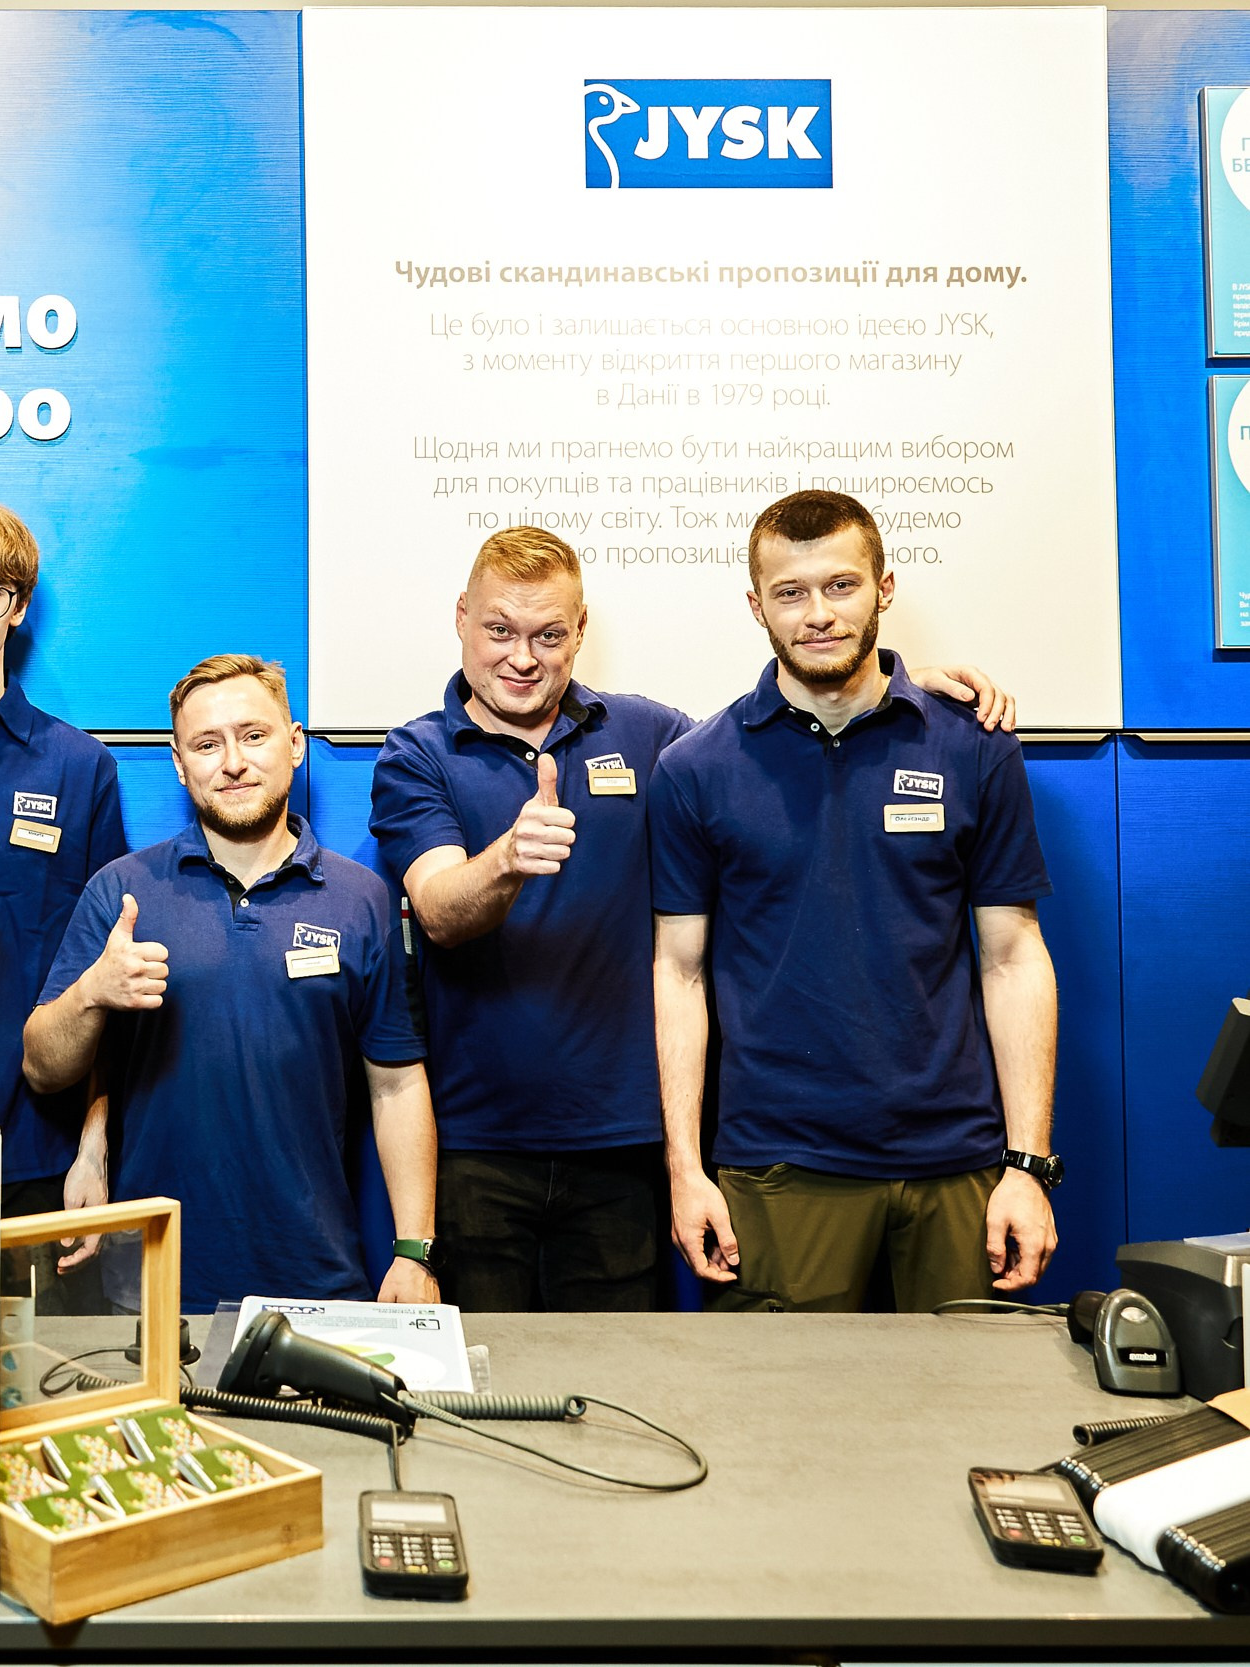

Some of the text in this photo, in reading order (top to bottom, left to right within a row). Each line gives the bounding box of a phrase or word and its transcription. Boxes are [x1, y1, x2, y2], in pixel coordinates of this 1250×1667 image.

[634, 105, 823, 160] JYSK
[395, 261, 1028, 290] Чудові скандинавські пропозиції для дому.
[430, 312, 994, 342] Це було і залишається основною ідеєю JYSK,
[463, 349, 963, 376] з моменту відкриття першого магазину
[597, 383, 831, 412] в Данії в 1979 році.
[413, 435, 1015, 464] Щодня ми прагнемо бути найкращим вибором
[433, 471, 994, 500] для покупців та працівників і поширюємось
[468, 506, 760, 534] по цілому світу. Тож ми
[870, 505, 961, 534] будемо
[606, 542, 750, 573] пропозиціє
[906, 777, 939, 791] JYSK
[24, 799, 51, 812] JYSK
[304, 930, 337, 948] JYSK
